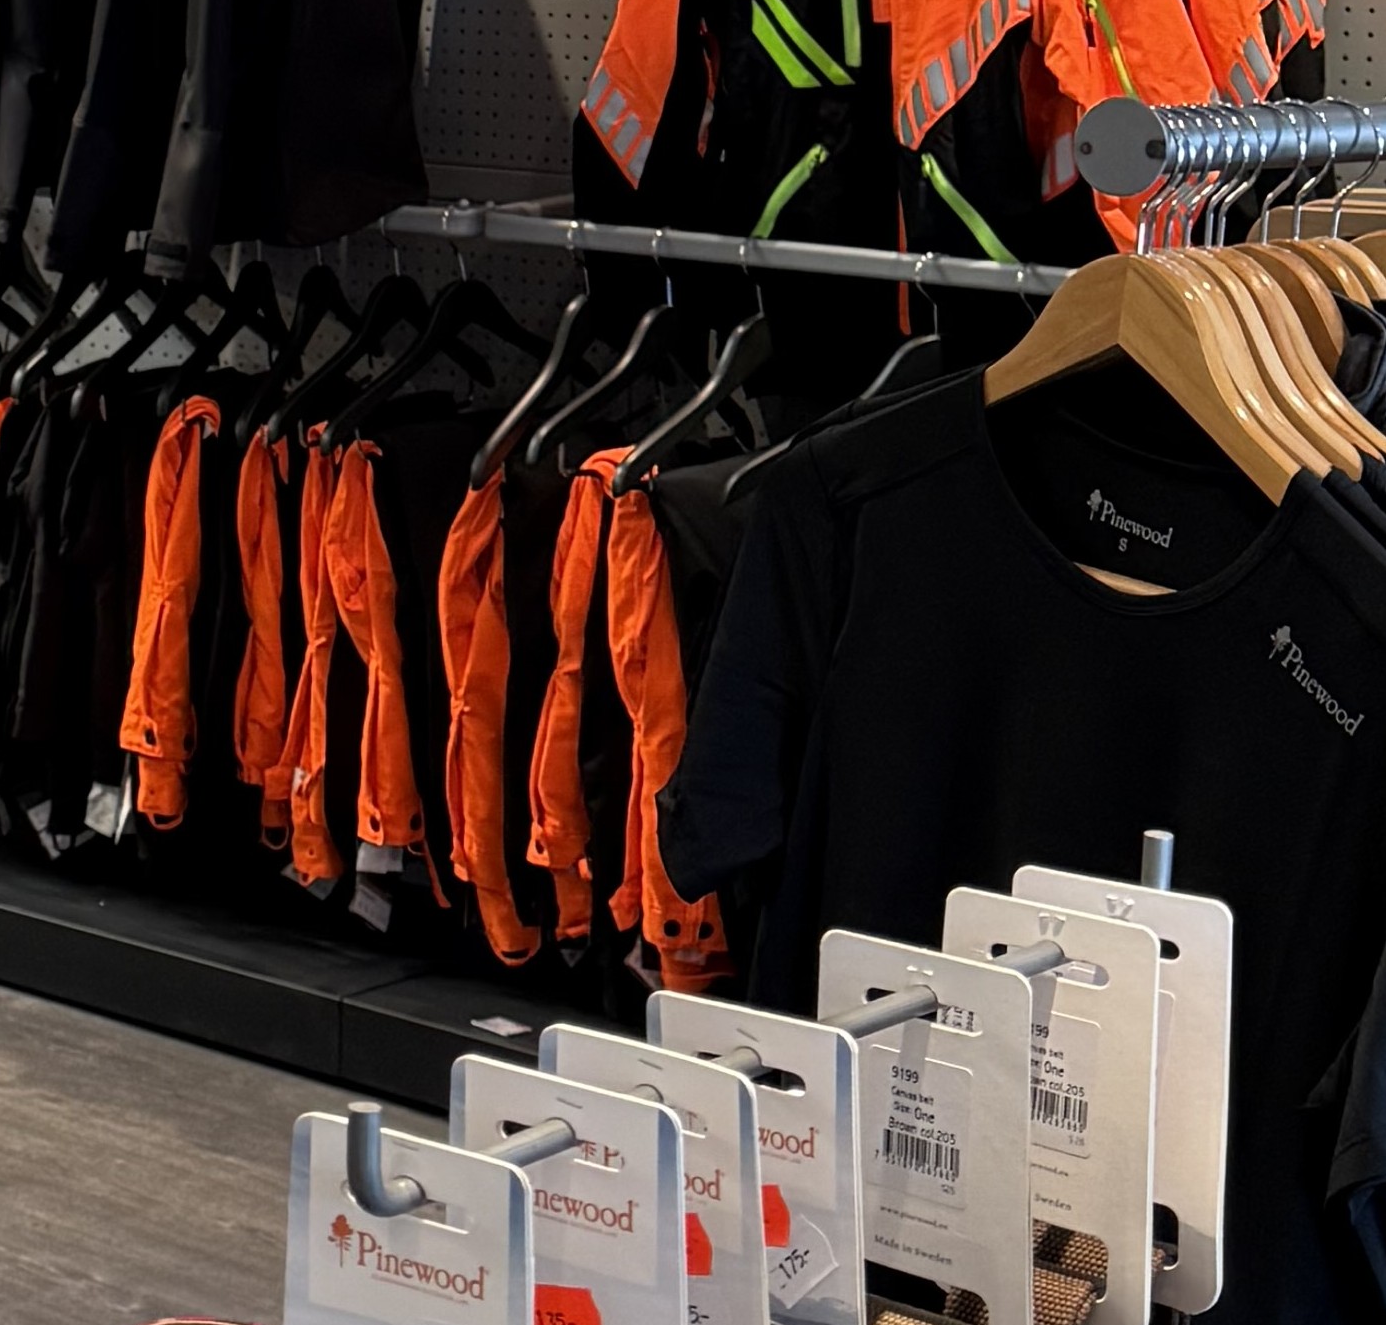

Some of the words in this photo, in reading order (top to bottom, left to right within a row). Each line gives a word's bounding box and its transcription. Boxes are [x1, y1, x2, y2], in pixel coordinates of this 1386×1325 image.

[1099, 499, 1174, 549] Pinewood
[1118, 537, 1129, 552] S
[1280, 643, 1365, 737] Pinewood
[891, 1065, 920, 1084] 9199
[1044, 1060, 1065, 1078] One
[888, 1116, 918, 1135] Brown
[914, 1106, 936, 1125] One
[758, 1126, 815, 1159] wood
[534, 1187, 635, 1233] newood
[357, 1231, 488, 1302] Pinewood
